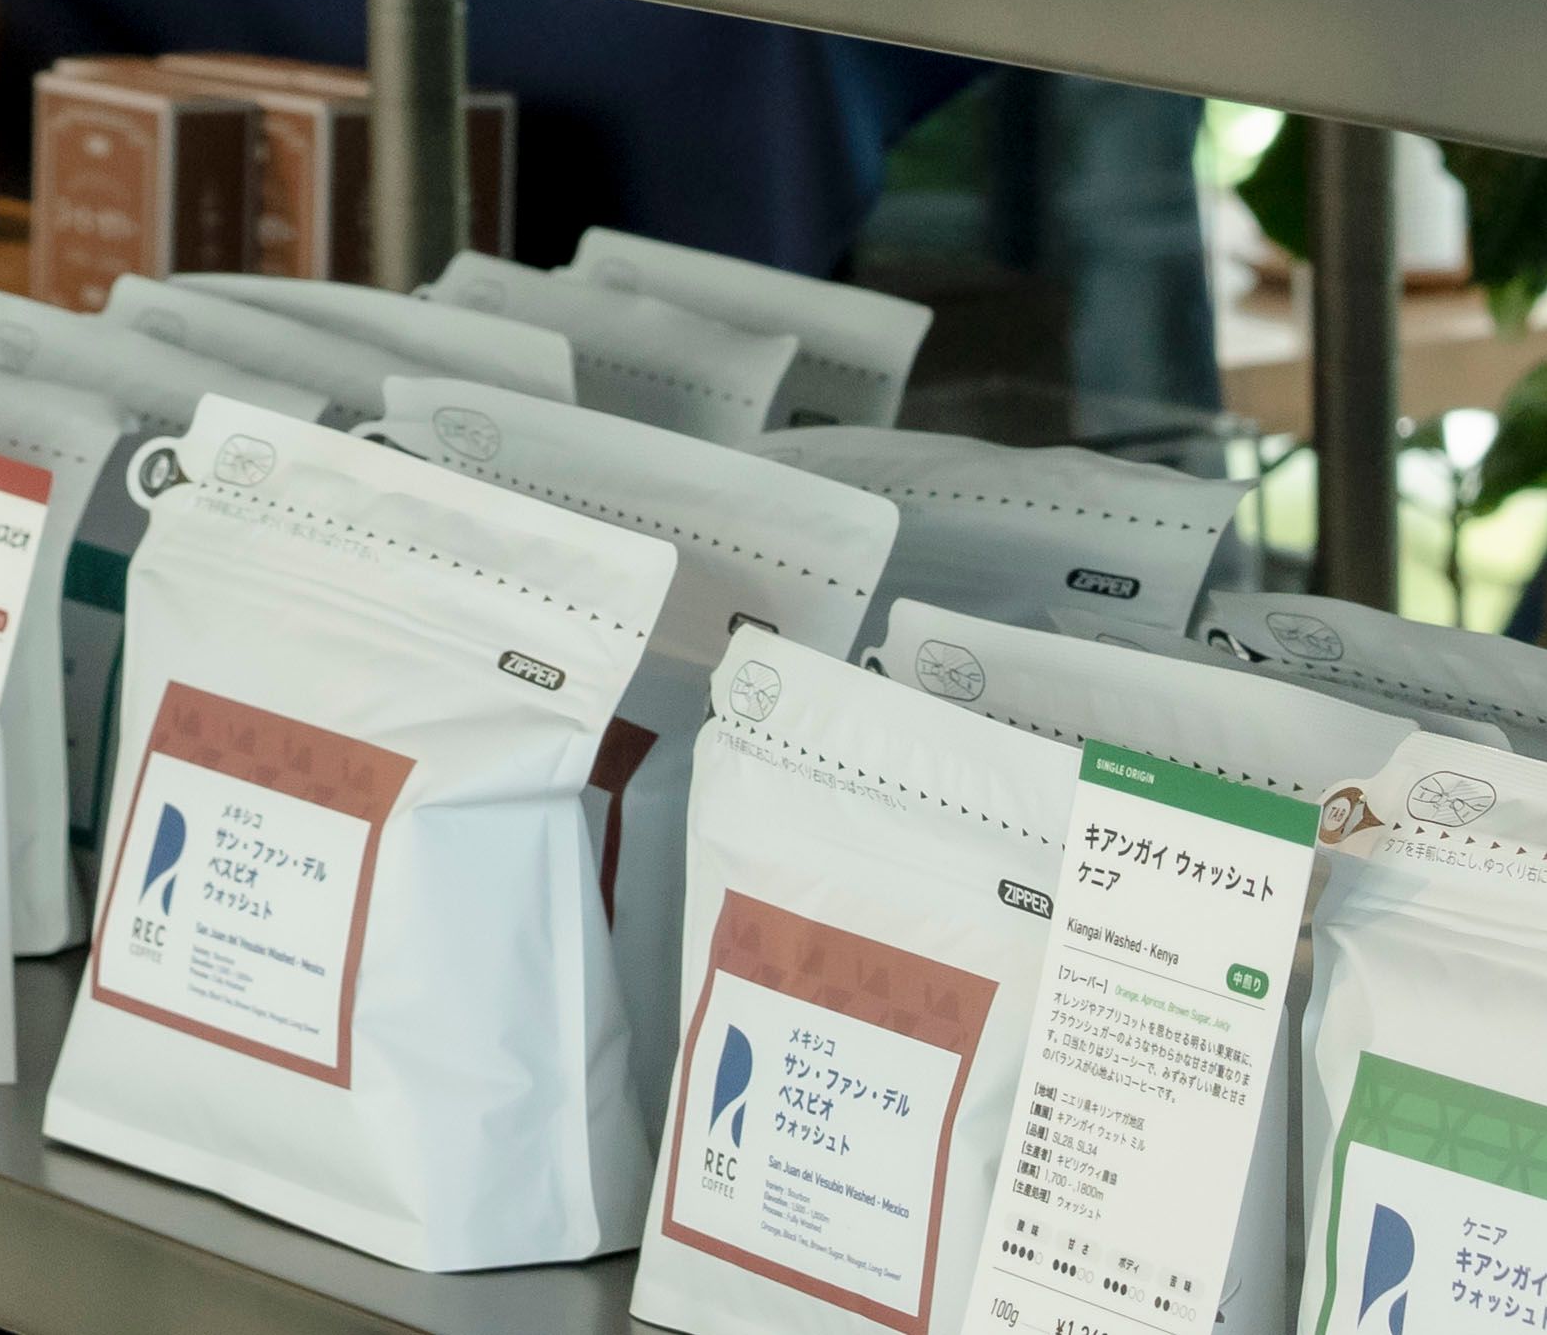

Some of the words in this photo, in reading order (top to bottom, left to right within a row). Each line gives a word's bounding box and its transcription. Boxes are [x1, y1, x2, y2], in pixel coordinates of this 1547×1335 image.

[1075, 571, 1135, 598] ZIPPER
[505, 653, 562, 689] ZIPPER
[1095, 757, 1125, 777] SINGLE
[1125, 764, 1156, 785] ORIGIN
[222, 804, 264, 829] メキシコ
[215, 828, 328, 882] サン・ファン・デル
[1084, 823, 1169, 871] キアンガイ
[1174, 849, 1275, 904] ウォッシュト
[1077, 860, 1122, 893] ケニア
[203, 881, 273, 920] ウォッシュト
[1003, 881, 1052, 918] ZIPPER
[131, 915, 167, 948] REC
[1066, 916, 1103, 943] Kiangai
[1104, 927, 1143, 955] Washed
[1148, 940, 1180, 967] Kenya
[1232, 968, 1263, 994] 中煎り
[788, 1027, 837, 1058] メキシコ
[1052, 990, 1254, 1068] オレンジやアプリコットを思わせる明るい果実味に、
[1050, 1008, 1252, 1088] ブラウンシュガーのようなやわらかな甘さが重なりま
[783, 1051, 911, 1118] サン・ファン・デル
[1041, 1045, 1178, 1105] のバランスが心地よいコーヒーです。
[1046, 1026, 1247, 1107] す。口当たりはジューシーで、みずみずしい酸と甘さ
[774, 1111, 852, 1157] ウォッシュト
[703, 1146, 739, 1182] REC
[701, 1175, 736, 1201] COFFEE
[1012, 1178, 1052, 1205] 【生産処理】
[1056, 1194, 1103, 1221] ウォッシュト
[1461, 1214, 1510, 1249] ケニア
[989, 1296, 1020, 1329] 100g
